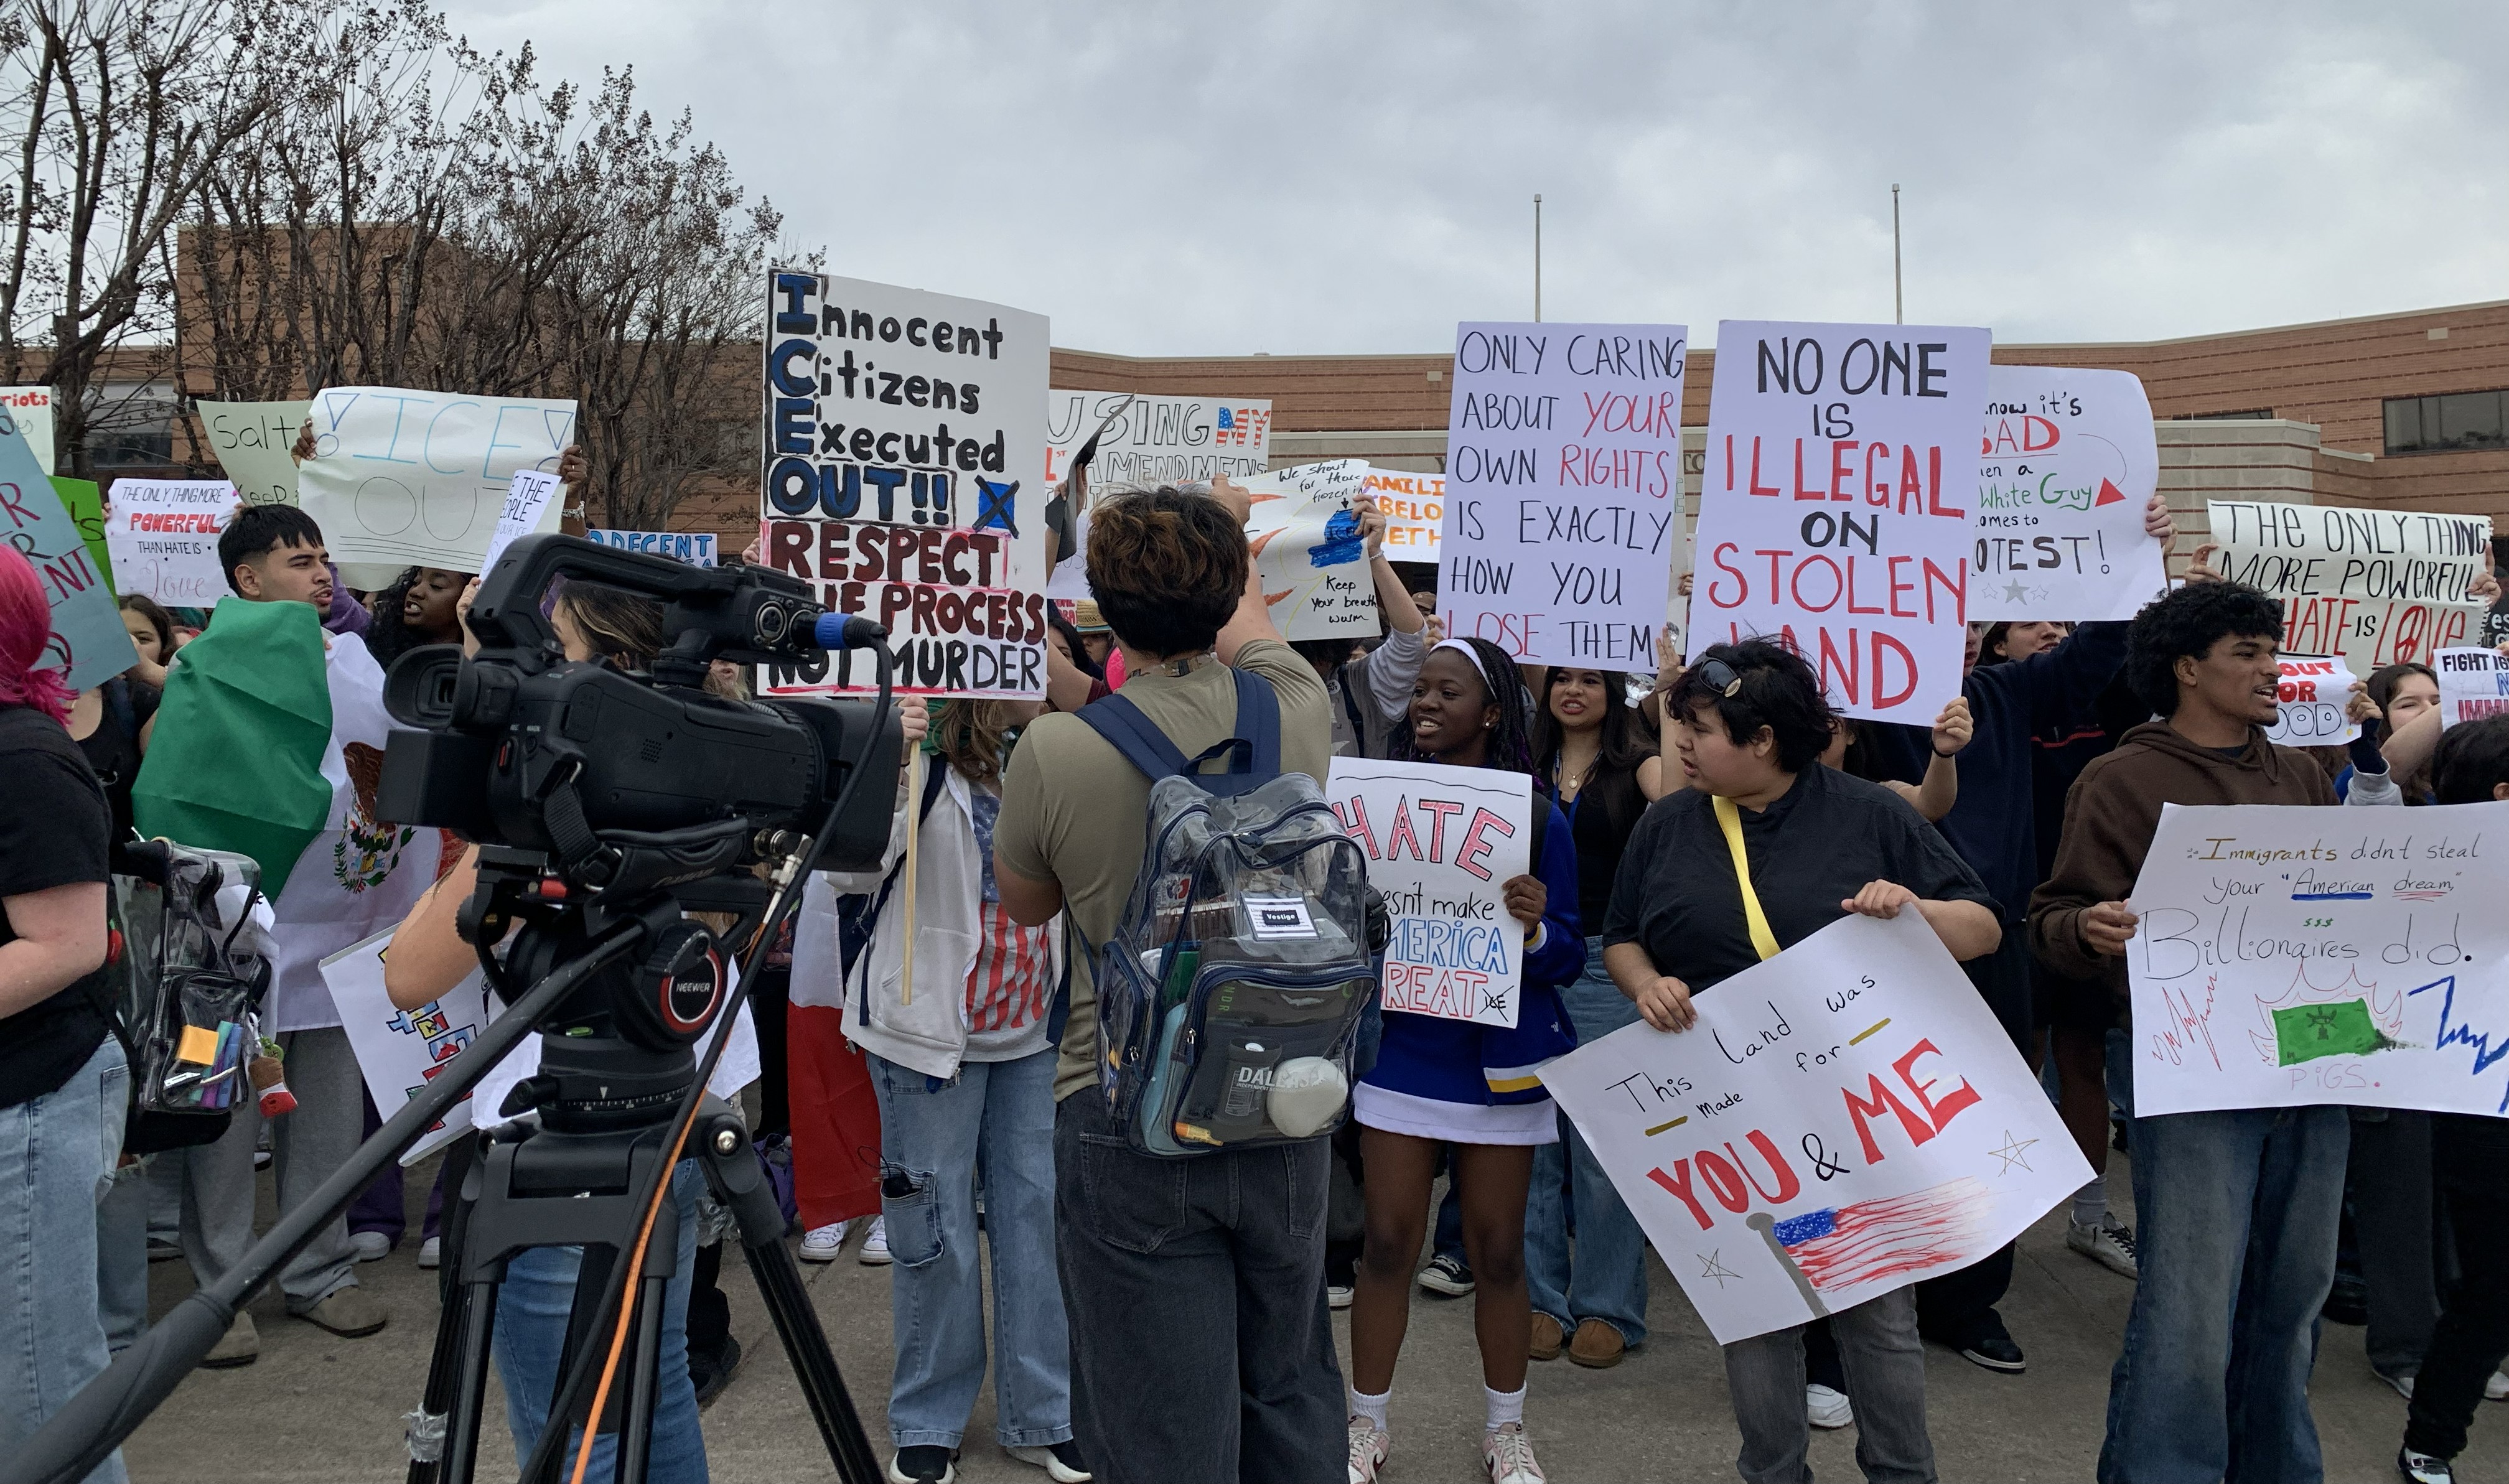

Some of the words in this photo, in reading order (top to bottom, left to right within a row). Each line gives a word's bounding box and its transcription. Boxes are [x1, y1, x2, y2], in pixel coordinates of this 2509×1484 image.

[777, 274, 1003, 359] Innocent
[770, 338, 979, 414] Citizens
[1460, 332, 1546, 375] ONLY
[1568, 335, 1684, 380] CARING
[1757, 337, 1823, 394] NO
[1840, 338, 1947, 398] ONE
[1047, 394, 1209, 446] USING
[1216, 407, 1271, 450] MY
[1462, 393, 1559, 430] ABOUT
[1583, 391, 1676, 438] YOUR
[1813, 402, 1854, 439] IS
[1985, 402, 2027, 415] now
[2040, 391, 2081, 416] it's
[213, 415, 295, 450] Salt
[776, 398, 1004, 472] Executed
[520, 477, 551, 503] THE
[770, 458, 948, 525] OUT!!
[1279, 467, 1299, 482] We
[1299, 478, 1315, 492] for
[1455, 446, 1536, 485] OWN
[1560, 444, 1669, 498] RIGHTS
[1726, 434, 1965, 519] ILLEGAL
[1979, 482, 2032, 510] White
[2039, 473, 2091, 511] Guy
[2018, 465, 2033, 475] a
[122, 487, 143, 501] THE
[171, 488, 200, 502] THING
[197, 488, 225, 503] MORE
[130, 513, 221, 534] POWERFUL
[1459, 501, 1483, 540] IS
[1520, 501, 1672, 554] EXACTLY
[1800, 511, 1879, 556] ON
[1976, 515, 2018, 528] omes
[2024, 513, 2039, 525] to
[2324, 510, 2408, 554] ONLY
[2418, 516, 2487, 556] THING
[138, 541, 162, 554] THAN
[164, 542, 191, 554] HATE
[194, 543, 201, 554] IS
[771, 522, 999, 587] RESPECT
[1973, 530, 2110, 575] OTEST!
[1327, 575, 1356, 594] Keep
[1451, 556, 1513, 594] HOW
[1551, 561, 1621, 605] YOU
[1708, 543, 1966, 627] STOLEN
[2221, 551, 2326, 595] MORE
[1311, 597, 1335, 612] your
[2355, 615, 2376, 637] IS
[876, 639, 1040, 691] MURDER
[2442, 653, 2489, 671] FIGHT
[1332, 794, 1515, 881] HATE
[2198, 838, 2337, 866] Immigrants
[2426, 833, 2481, 859] steal
[1432, 892, 1494, 920] make
[2203, 876, 2265, 904] your
[2136, 906, 2359, 980] Billionaires
[2382, 913, 2472, 964] did.
[676, 982, 711, 992] NEEWER
[1382, 962, 1488, 1017] REAT
[1796, 1045, 1840, 1072] for
[1605, 1071, 1692, 1112] This
[1646, 1129, 1800, 1231] YOU
[1801, 1133, 1850, 1182] &
[1841, 1037, 1982, 1166] ME
